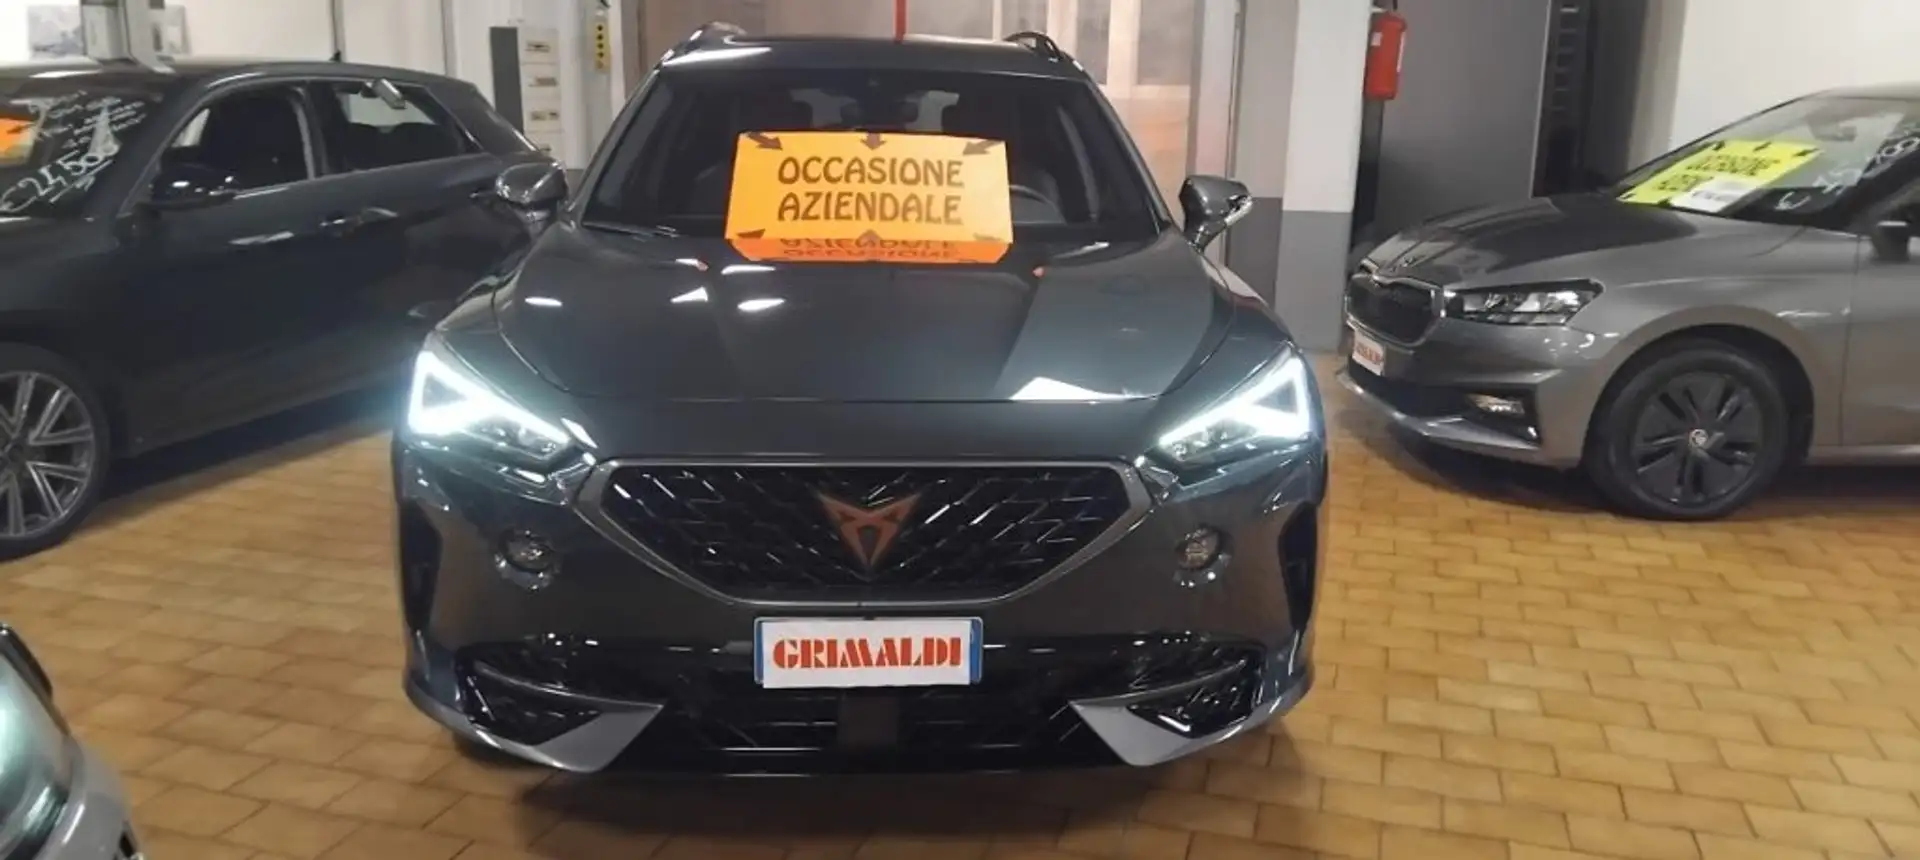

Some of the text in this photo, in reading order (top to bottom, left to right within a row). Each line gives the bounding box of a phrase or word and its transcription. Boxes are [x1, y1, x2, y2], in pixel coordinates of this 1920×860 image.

[778, 156, 965, 188] OCCASIONE
[777, 191, 964, 225] AZIENDALE
[773, 637, 961, 669] GRIMALDI
